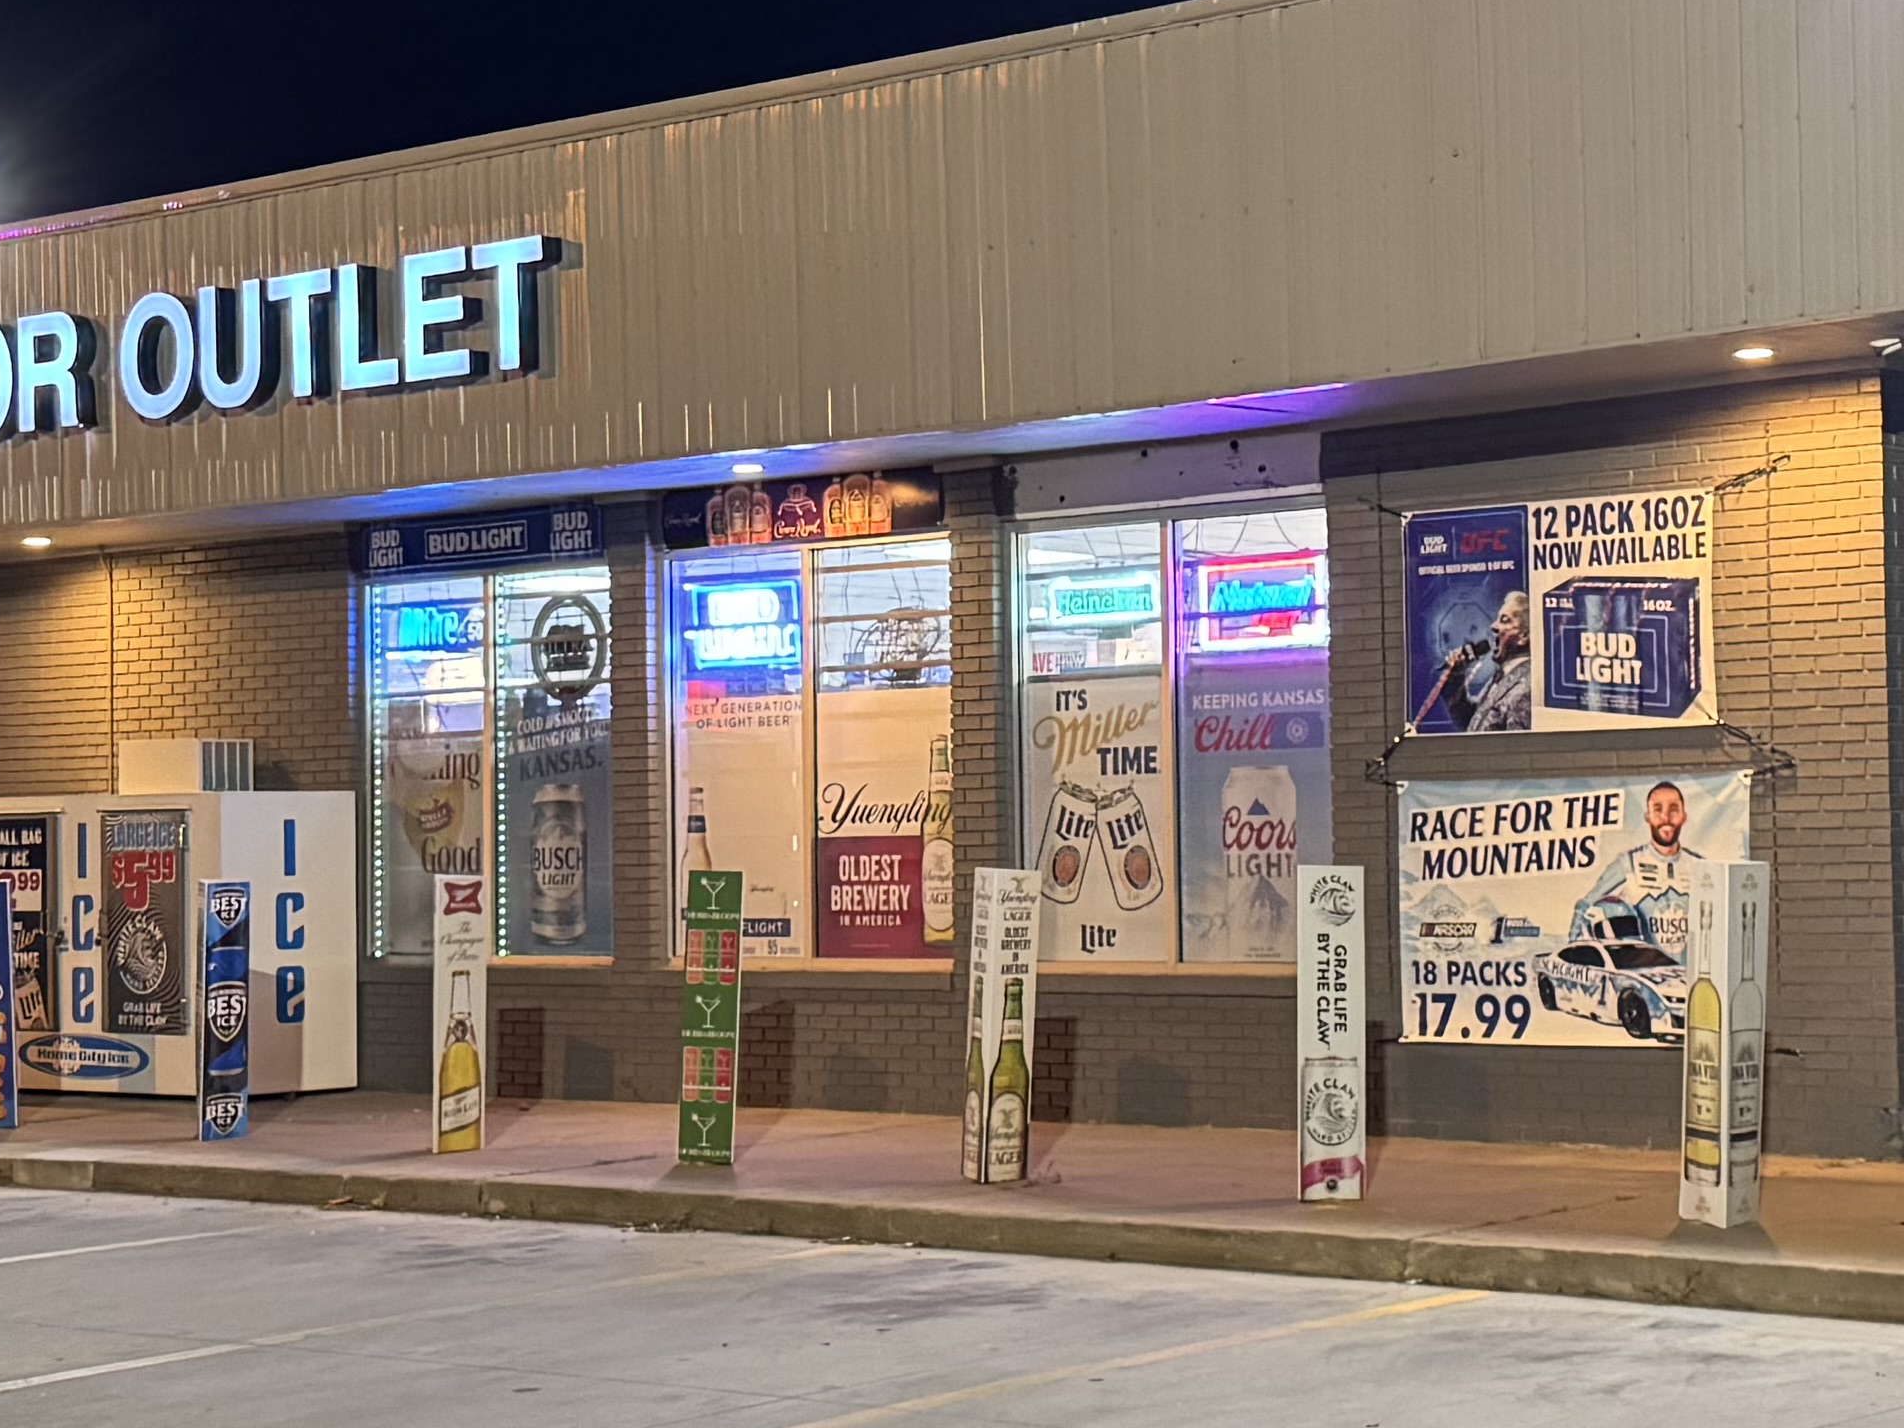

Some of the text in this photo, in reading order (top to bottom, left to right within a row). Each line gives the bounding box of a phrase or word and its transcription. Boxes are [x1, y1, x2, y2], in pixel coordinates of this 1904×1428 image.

[119, 234, 546, 420] OUTLET
[553, 511, 588, 531] BUD
[1532, 494, 1707, 540] 12 PACK 16OZ
[371, 529, 400, 549] BUD
[428, 526, 524, 555] BUD LIGHT
[550, 529, 593, 551] LIGHT
[1420, 543, 1448, 555] LIGHT
[1459, 528, 1512, 555] UFC
[1533, 531, 1708, 571] NOW AVAILABLE
[369, 547, 404, 568] LIGHT
[1580, 632, 1637, 660] BUD
[1575, 656, 1643, 685] LIGHT
[685, 700, 803, 716] NEXT GENERATION
[1055, 689, 1088, 712] IT'S
[1192, 688, 1325, 710] KEEPING KANSAS
[517, 716, 544, 736] COLD
[696, 718, 715, 730] OF
[757, 715, 791, 728] BEER
[1194, 711, 1278, 753] Chill
[1032, 699, 1159, 774] Miller
[518, 745, 604, 783] KANSAS.
[817, 782, 953, 835] Yuengling
[1410, 791, 1621, 844] RACE FOR THE
[1054, 804, 1096, 842] Lite
[1106, 807, 1145, 850] Lite
[1222, 805, 1296, 851] Coors
[20, 827, 42, 846] BAG
[11, 851, 30, 867] ICE
[420, 836, 482, 874] Good
[532, 846, 585, 872] BUSCH
[838, 854, 902, 882] OLDEST
[1225, 851, 1295, 879] LIGHT
[1421, 834, 1596, 881] MOUNTAINS
[541, 872, 576, 887] LIGHT
[1329, 874, 1356, 892] CLAW
[210, 895, 248, 914] BEST
[830, 884, 911, 912] BREWERY
[839, 914, 902, 927] IN AMERICA
[1432, 923, 1476, 937] NASCAR
[1650, 916, 1689, 934] BUSC
[1080, 923, 1117, 955] Lite
[13, 951, 41, 969] TIME
[1411, 959, 1528, 988] 18 PACKS
[1316, 932, 1330, 1047] BY THE CLAW
[1333, 944, 1348, 1033] GRAB LIFE
[207, 994, 247, 1019] BEST
[1412, 991, 1532, 1041] 17.99
[216, 1015, 237, 1028] ICE
[37, 1048, 77, 1060] Home
[1322, 1077, 1356, 1100] CLAW
[206, 1102, 245, 1122] BEST
